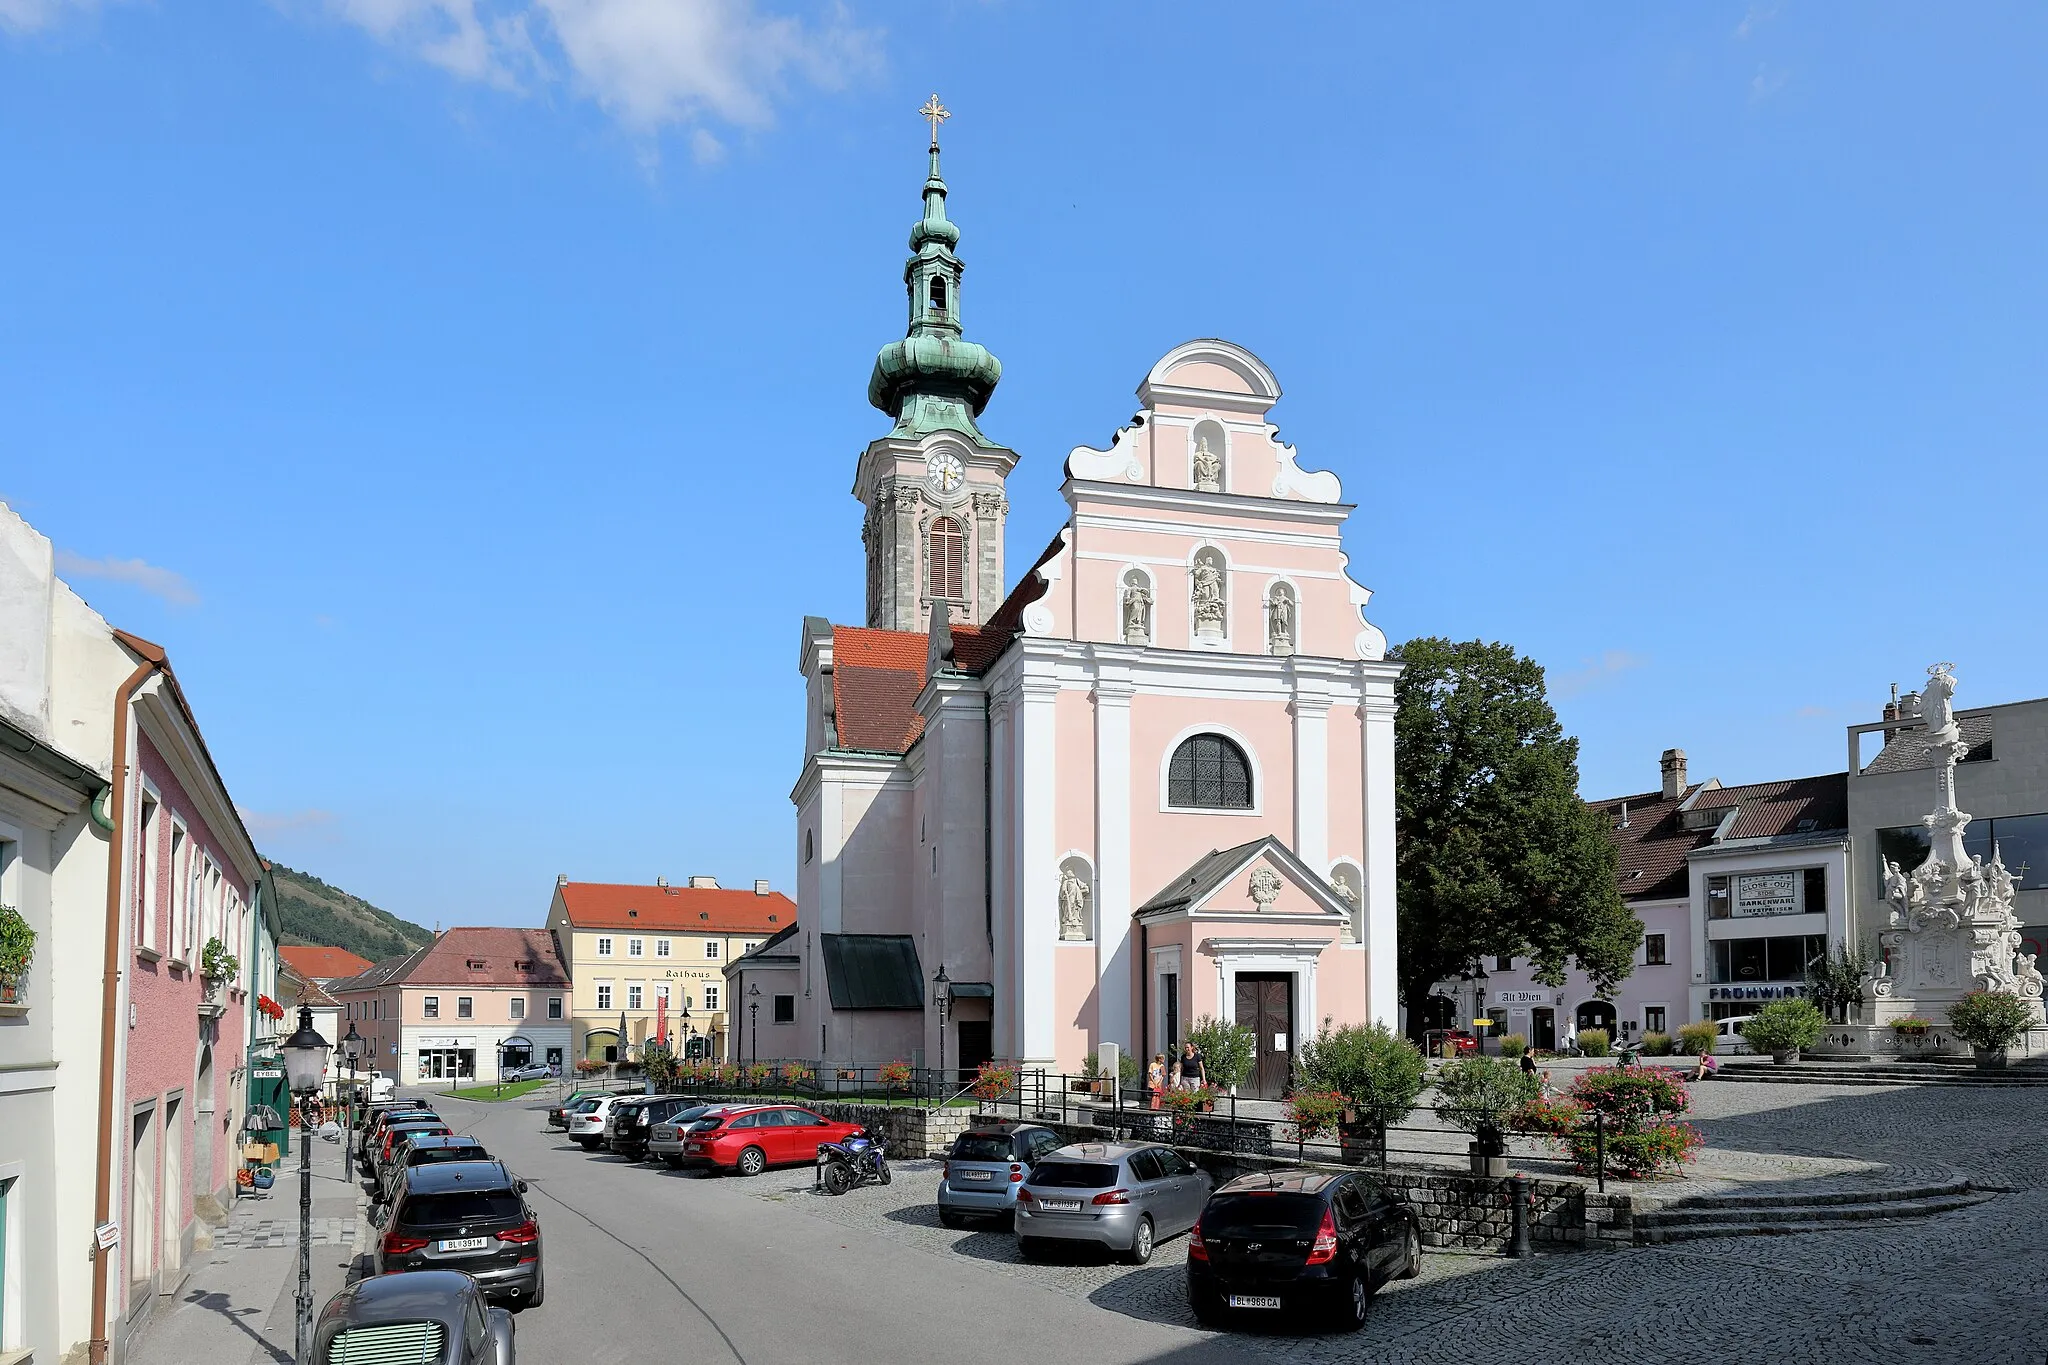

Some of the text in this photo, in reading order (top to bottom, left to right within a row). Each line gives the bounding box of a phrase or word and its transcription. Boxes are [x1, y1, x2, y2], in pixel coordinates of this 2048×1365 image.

[1739, 898, 1796, 907] MARKENWARE
[1742, 906, 1793, 914] TIEFSTPREISEN
[666, 969, 710, 978] Rathaus
[1502, 992, 1541, 1002] Alt Wien
[448, 1241, 457, 1249] BL
[1236, 1296, 1245, 1306] BL
